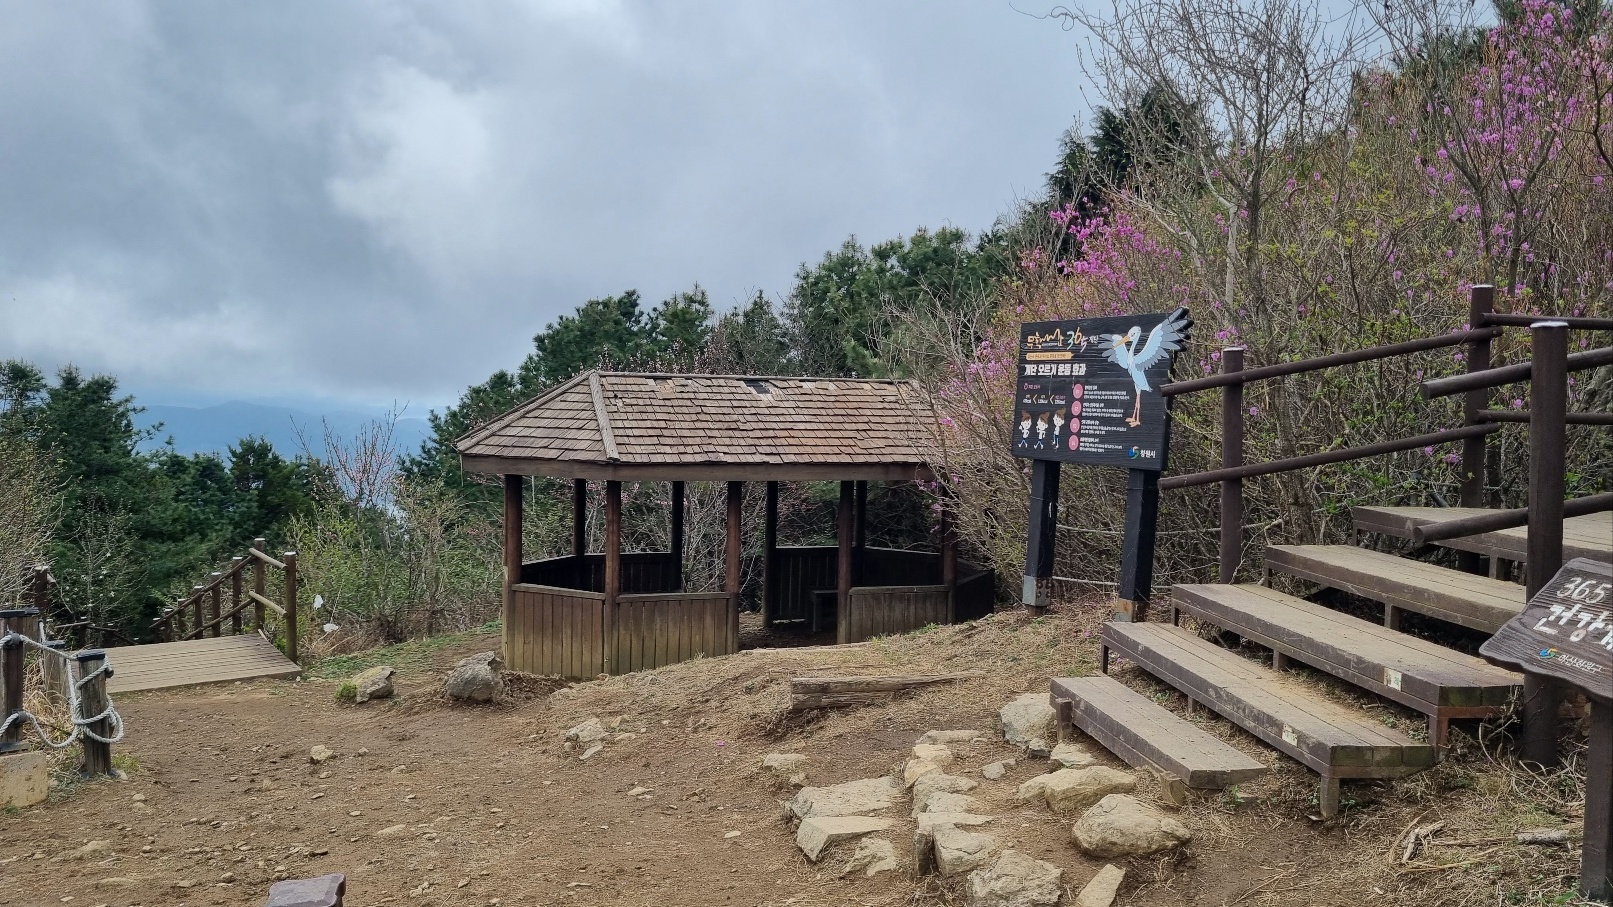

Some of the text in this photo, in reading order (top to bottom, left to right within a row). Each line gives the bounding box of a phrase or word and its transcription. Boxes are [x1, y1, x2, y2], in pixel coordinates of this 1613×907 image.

[1027, 328, 1064, 349] 무학산
[1066, 326, 1088, 352] 365
[1024, 363, 1086, 376] 계단 오르기 운동 효과
[1140, 449, 1156, 458] 창원시
[1556, 577, 1612, 604] 365
